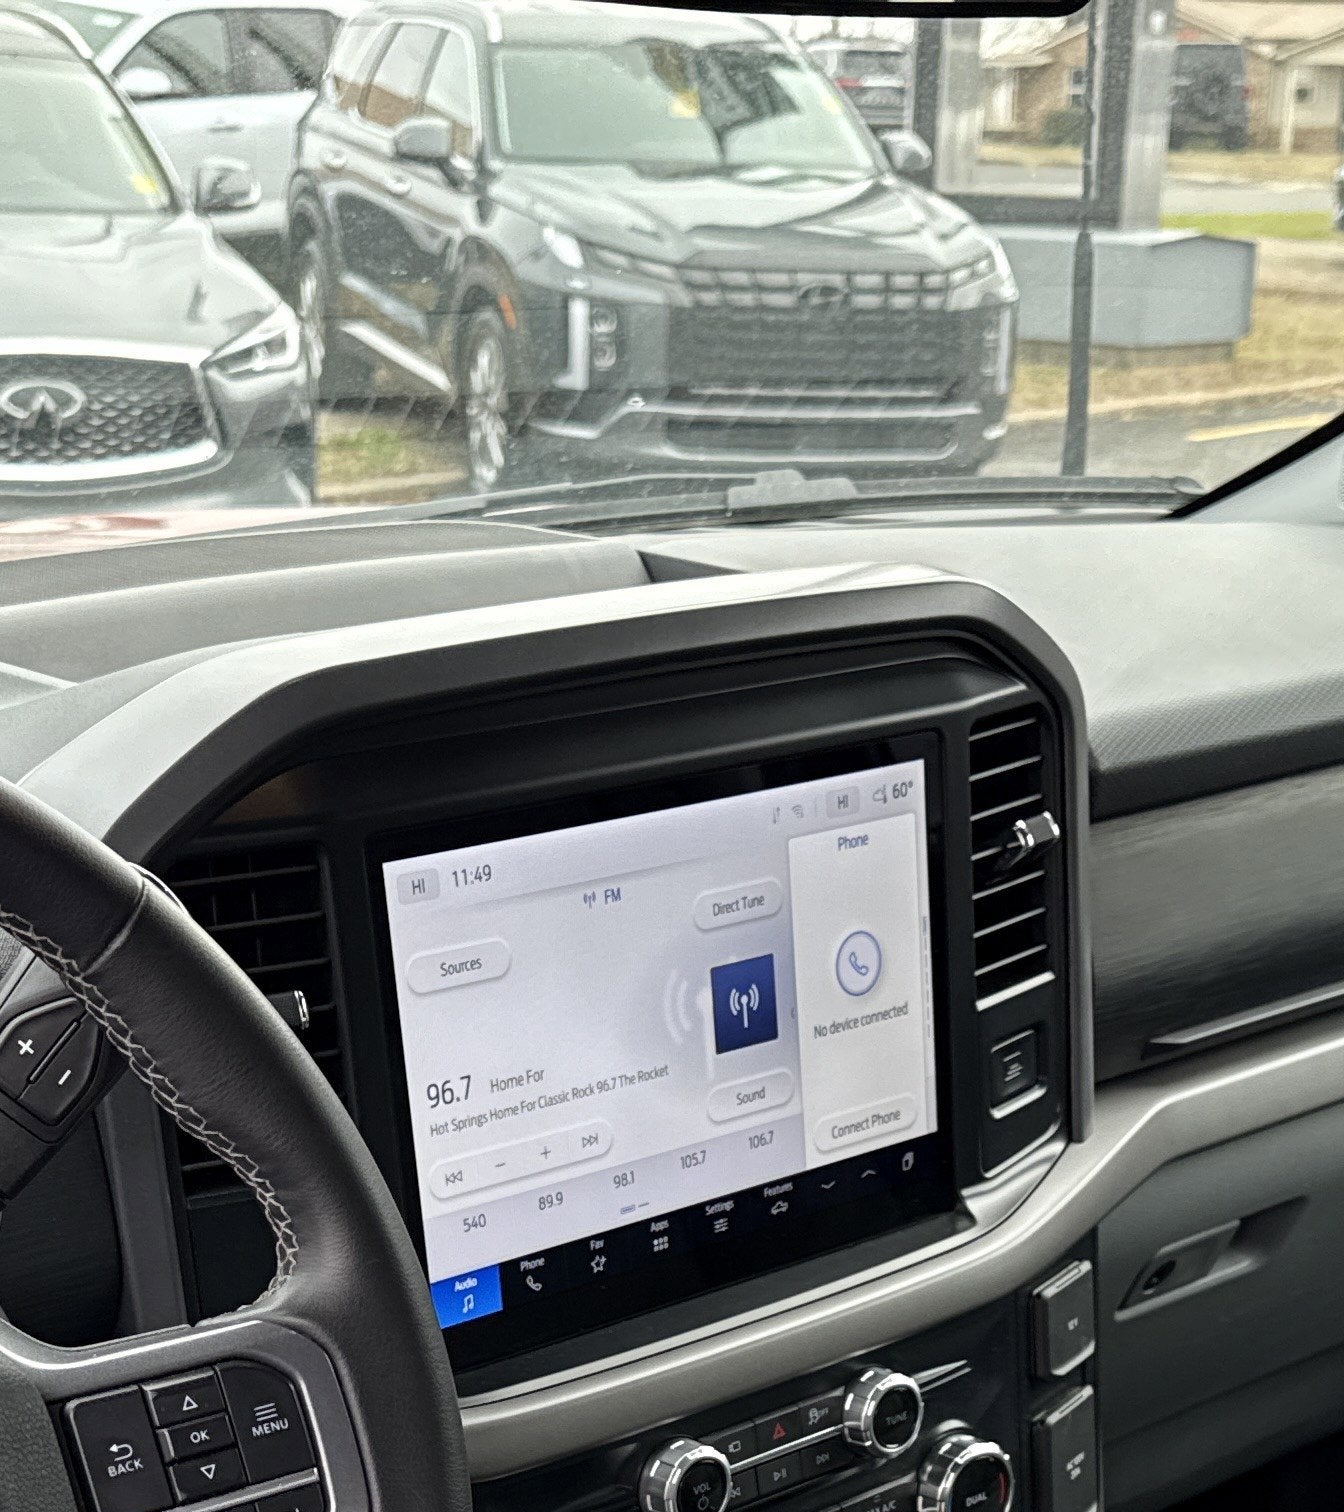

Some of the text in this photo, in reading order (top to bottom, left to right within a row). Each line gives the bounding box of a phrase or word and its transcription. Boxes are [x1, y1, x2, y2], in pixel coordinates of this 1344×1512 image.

[837, 834, 869, 851] Phone
[451, 863, 492, 888] 11:49
[411, 878, 426, 895] HI
[604, 887, 622, 905] FM
[712, 894, 765, 917] Direct Tune
[440, 957, 482, 978] Sources
[813, 1002, 909, 1039] No device connected
[425, 1068, 545, 1109] 96.7 Home For
[736, 1086, 766, 1106] Sound
[429, 1064, 669, 1137] Hot Springs Home For Classic Rock 96.7 The Rocket
[831, 1109, 901, 1140] Connect Phone
[748, 1130, 774, 1150] 106.7
[680, 1150, 706, 1170] 105.7
[613, 1170, 635, 1189] 98.1
[538, 1191, 564, 1211] 89.9
[463, 1213, 487, 1233] 540
[650, 1219, 669, 1233] Apps
[520, 1257, 545, 1272] Phone
[454, 1276, 478, 1292] Audio
[190, 1429, 210, 1444] OK
[251, 1418, 289, 1438] MENU
[107, 1458, 144, 1477] BACK
